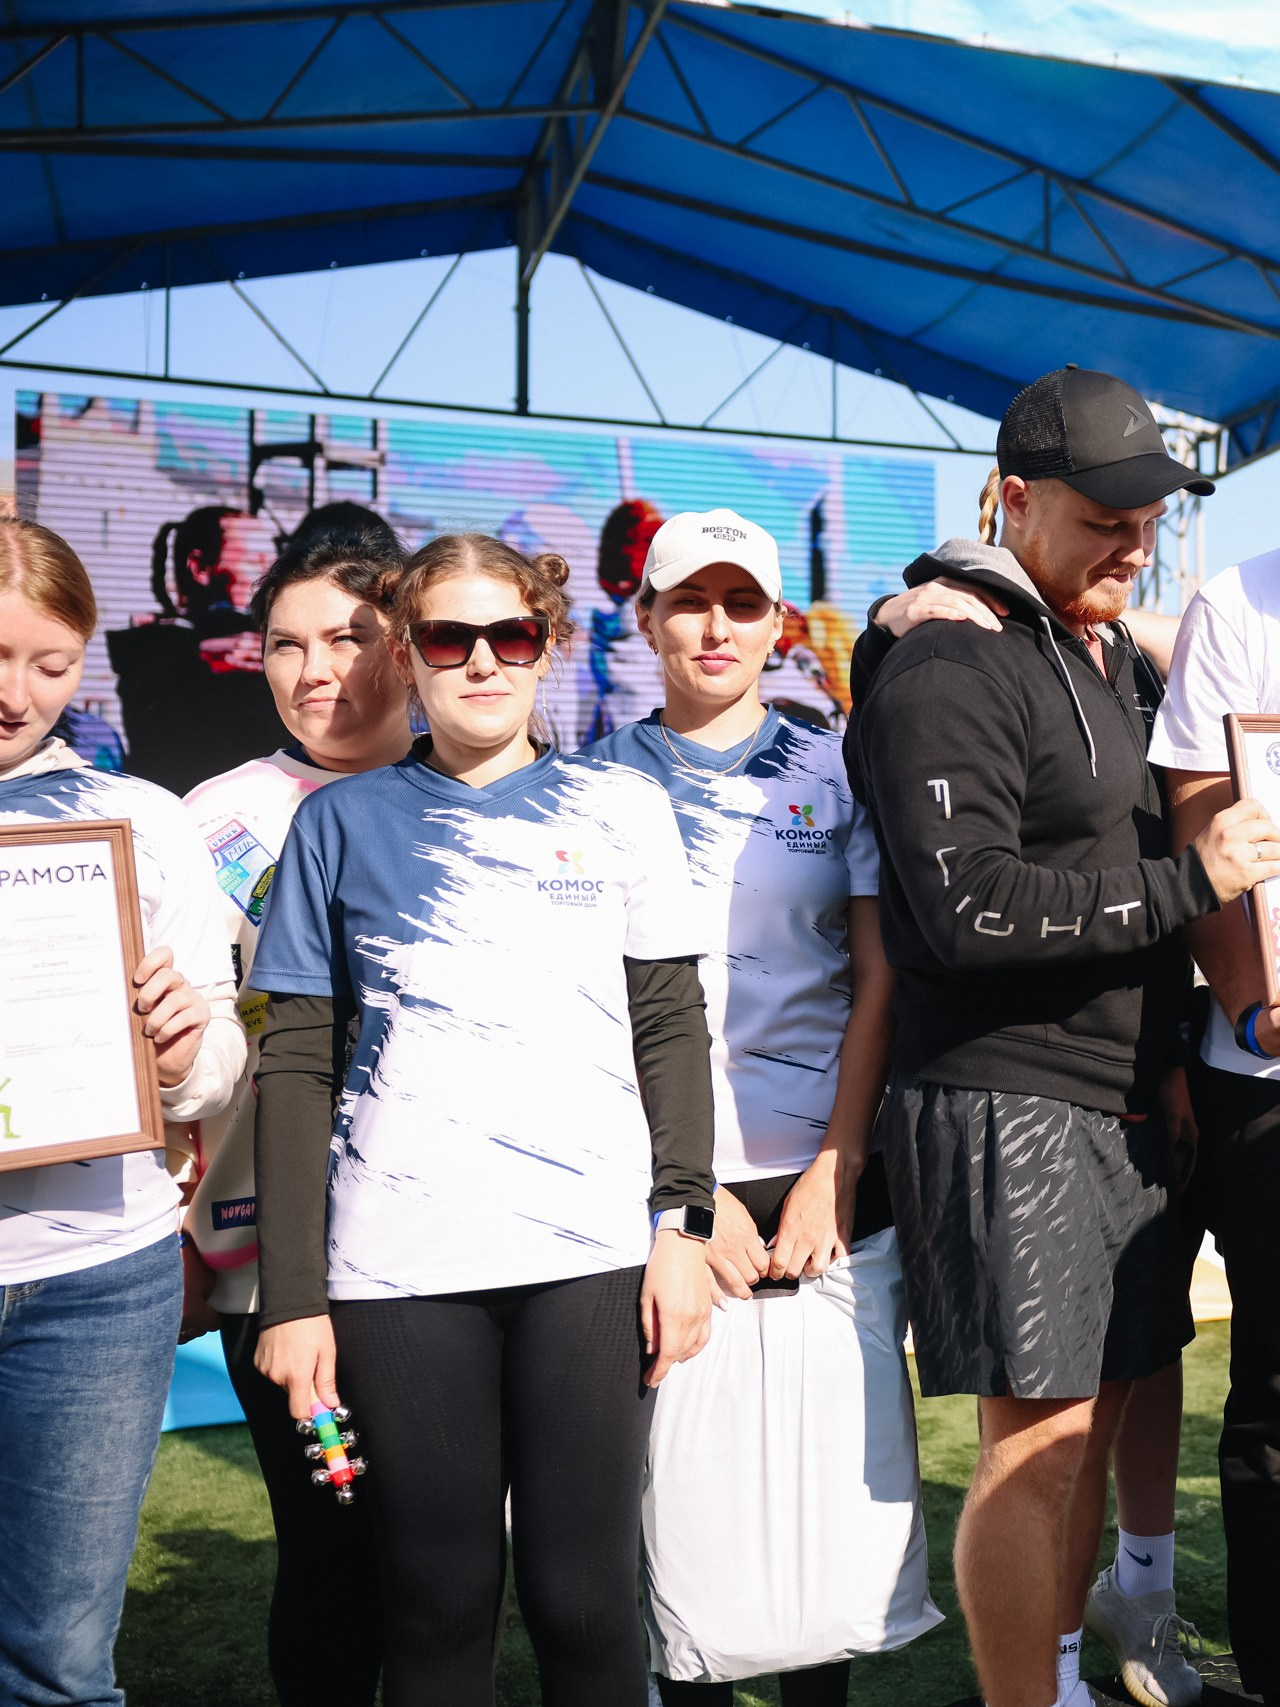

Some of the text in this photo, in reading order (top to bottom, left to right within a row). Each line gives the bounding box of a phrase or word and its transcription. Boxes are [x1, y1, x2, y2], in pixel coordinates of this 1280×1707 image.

[701, 526, 747, 540] BOSTON
[775, 829, 834, 841] КОМОС
[786, 841, 827, 849] ЕДИНЫЙ
[0, 863, 108, 887] РАМОТА
[537, 879, 605, 893] КОМОС
[549, 893, 597, 902] ЕДИНЫЙ
[240, 1003, 268, 1018] RACE
